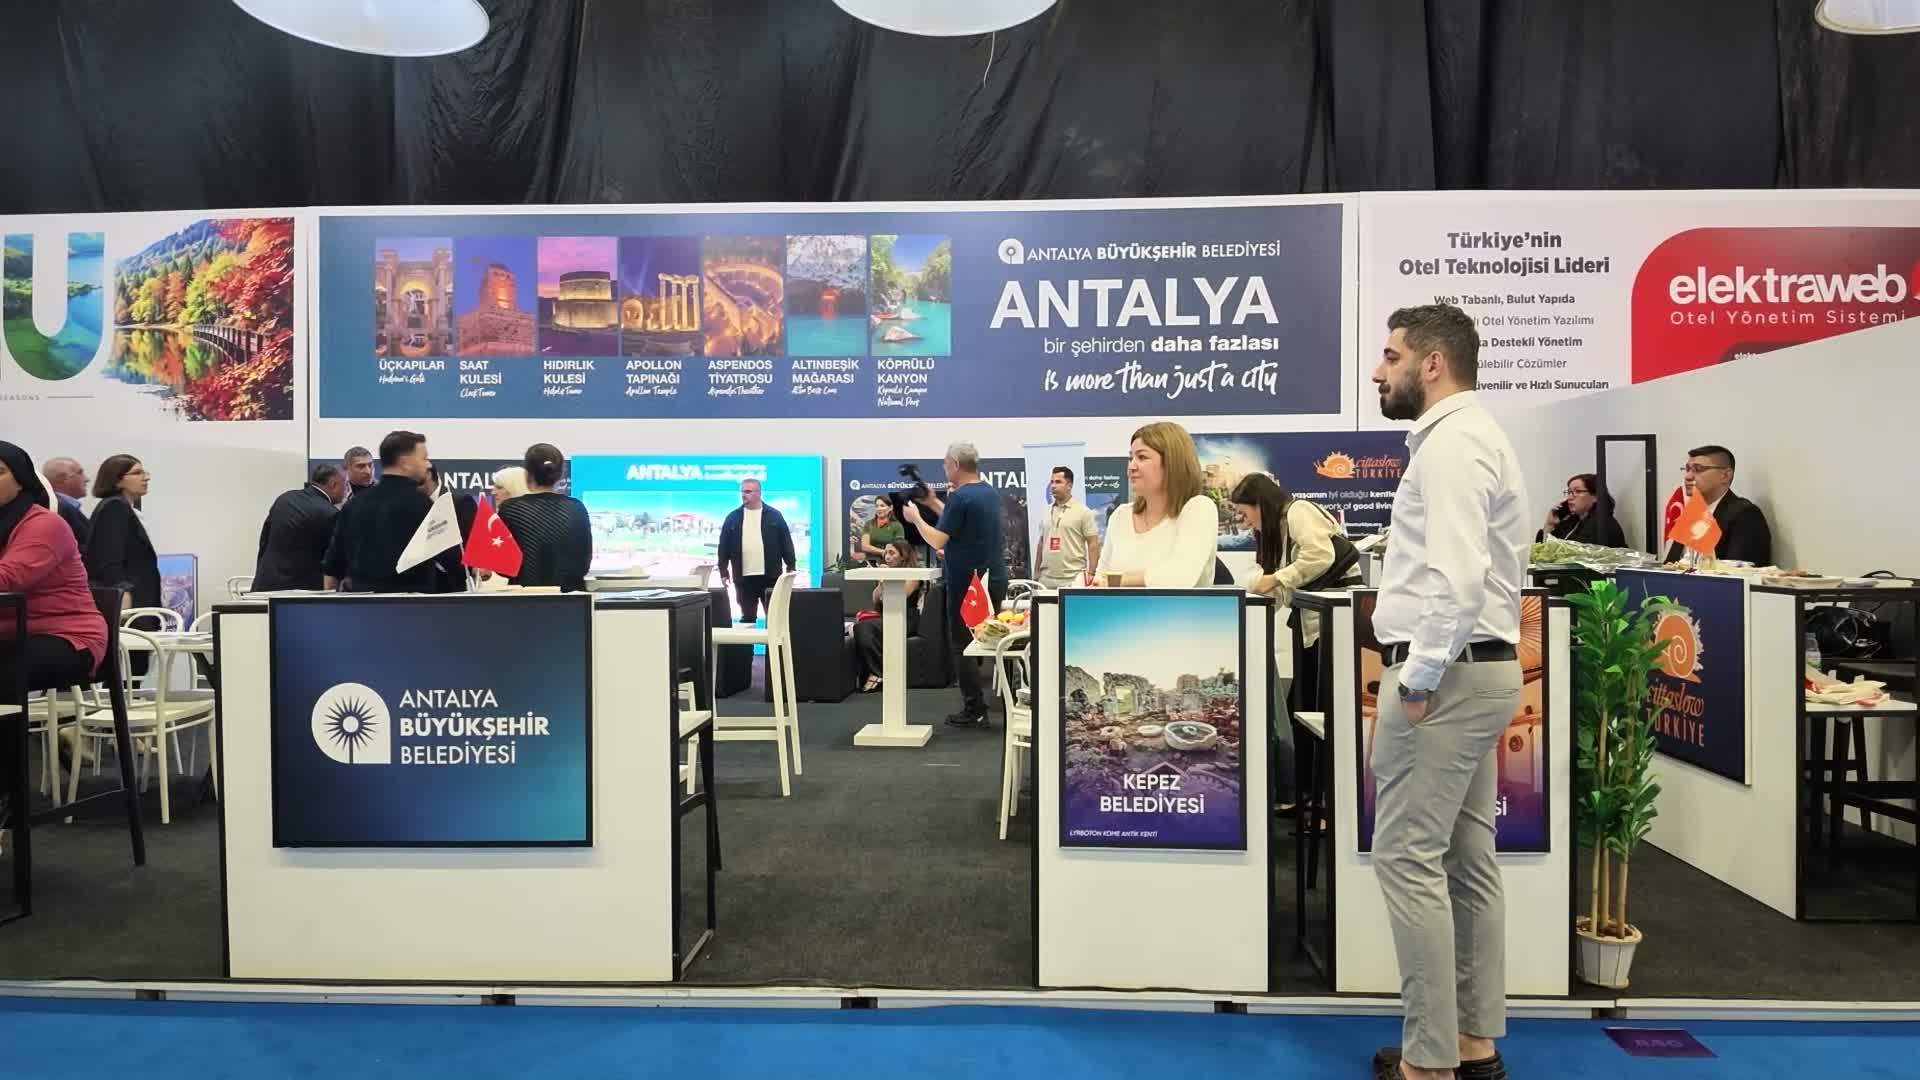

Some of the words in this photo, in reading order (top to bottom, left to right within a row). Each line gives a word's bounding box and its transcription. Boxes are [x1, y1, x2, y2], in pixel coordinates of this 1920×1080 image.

[1448, 232, 1562, 250] Türkiye’nin
[1027, 247, 1093, 261] ANTALYA
[1096, 242, 1197, 262] BÜYÜKŞEHİR
[1202, 240, 1281, 258] BELEDİYESİ
[1399, 258, 1440, 276] Otel
[1445, 258, 1550, 276] Teknolojisi
[1554, 257, 1610, 274] Lideri
[1669, 264, 1907, 305] elektraweb
[990, 276, 1279, 328] ANTALYA
[1434, 294, 1459, 305] Web
[1461, 294, 1504, 306] Tabanlı,
[1506, 294, 1536, 304] Bulut
[1538, 294, 1576, 306] Yapıda
[1482, 316, 1504, 326] Otel
[1507, 314, 1550, 326] Yönetim
[1553, 315, 1594, 326] Yazılımı
[1670, 311, 1716, 326] Otel
[1727, 310, 1815, 325] Yönetim
[1826, 310, 1905, 324] Sistemi
[1044, 337, 1065, 353] bir
[1071, 336, 1145, 357] şehirden
[1151, 336, 1202, 352] daha
[1209, 335, 1280, 351] fazlası
[1492, 337, 1535, 347] Destekli
[1538, 336, 1582, 347] Yönetim
[379, 358, 445, 372] ÜÇKAPILAR
[460, 360, 489, 370] SAAT
[544, 360, 594, 370] HIDIRLIK
[626, 360, 682, 370] APOLLON
[708, 360, 773, 370] ASPENDOS
[792, 358, 860, 372] ALTINBEŞİK
[878, 358, 935, 370] KÖPRÜLÜ
[1516, 358, 1567, 370] Çözümler
[460, 372, 502, 384] KULESİ
[544, 372, 586, 384] KULESİ
[626, 372, 680, 384] TAPINAĞI
[708, 372, 773, 384] TİYATROSU
[792, 372, 854, 384] MAĞARASI
[878, 374, 928, 384] KANYON
[1065, 371, 1115, 392] more
[1115, 360, 1168, 393] than
[1167, 362, 1229, 399] just
[1221, 371, 1234, 388] a
[1241, 360, 1279, 396] city
[1530, 380, 1552, 390] Hızlı
[626, 464, 704, 480] ANTALYA
[444, 472, 495, 490] NTAL
[1353, 502, 1374, 512] good
[1376, 502, 1392, 510] livin
[400, 688, 499, 708] ANTALYA
[400, 712, 550, 740] BÜYÜKŞEHİR
[400, 740, 516, 765] BELEDİYESİ
[1124, 774, 1181, 790] KEPEZ
[1100, 794, 1205, 814] BELEDİYESİ
